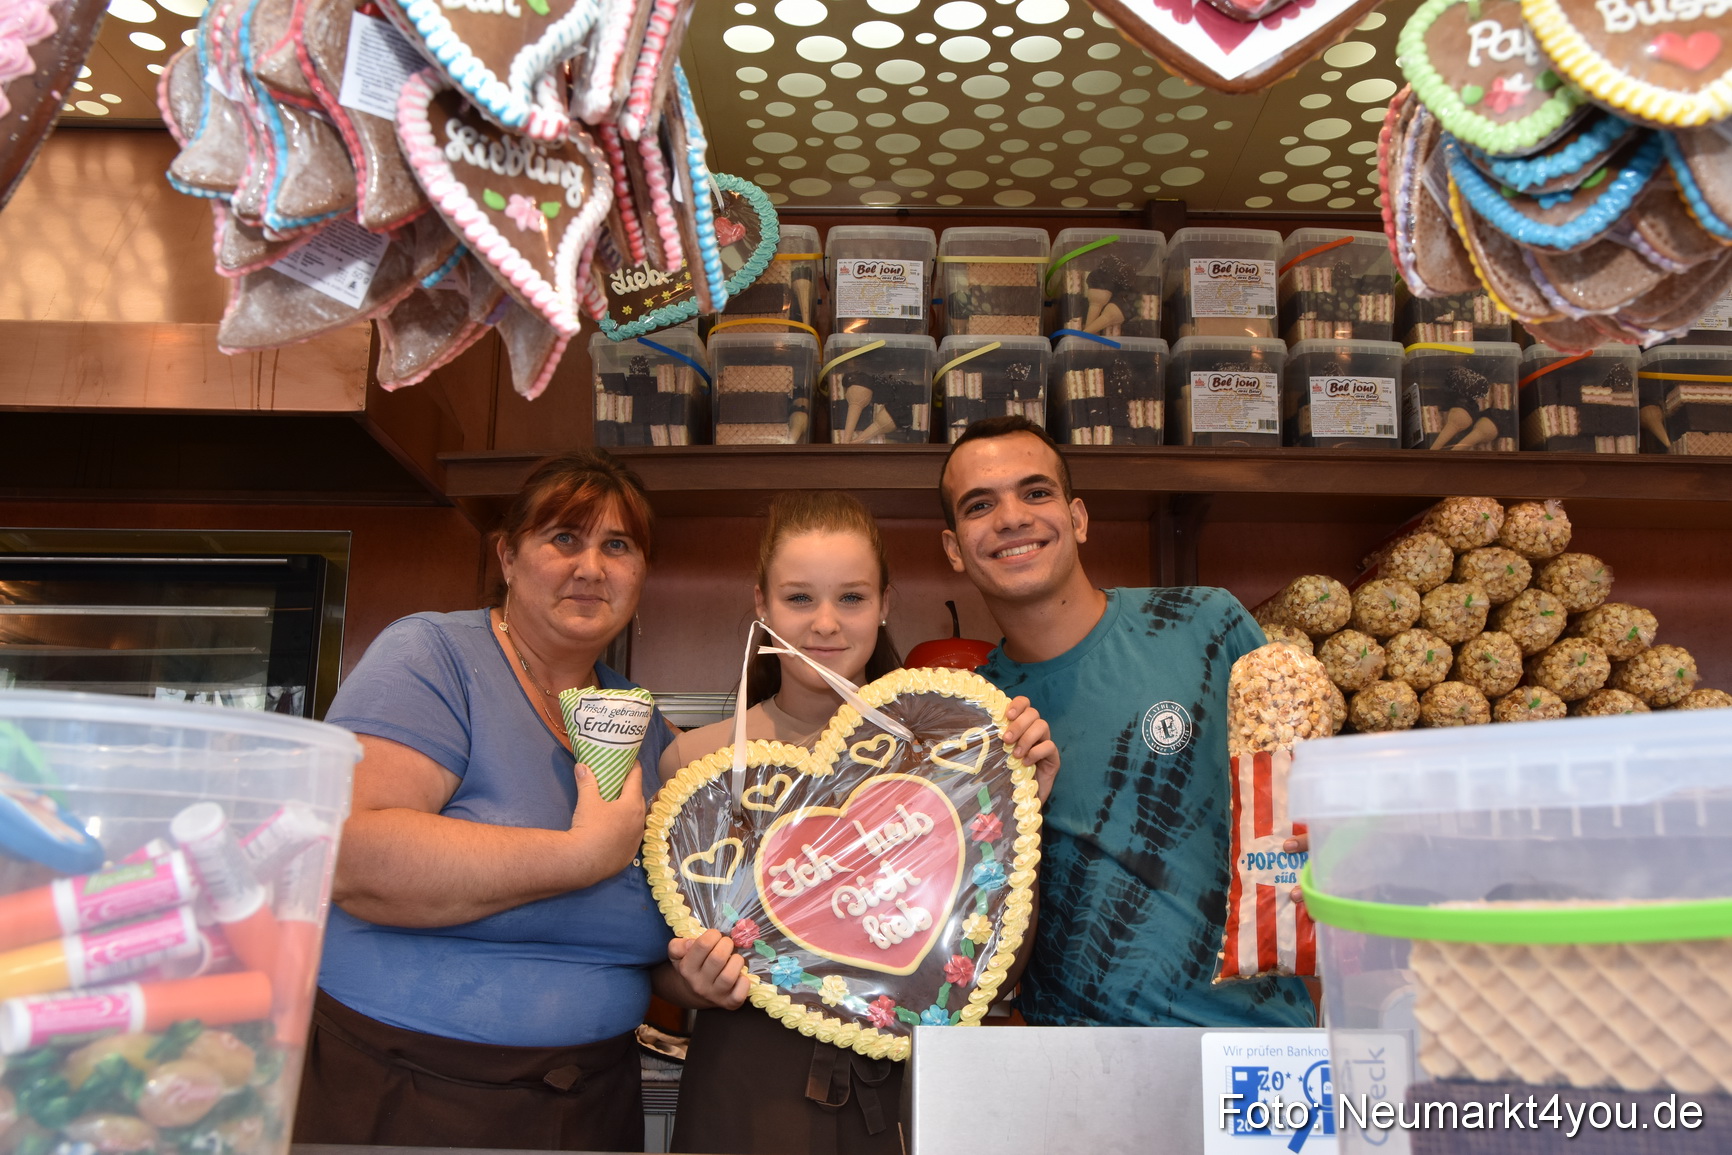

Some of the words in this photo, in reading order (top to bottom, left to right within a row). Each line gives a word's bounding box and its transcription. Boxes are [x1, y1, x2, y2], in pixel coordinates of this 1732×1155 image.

[444, 118, 585, 208] Liebling
[857, 264, 877, 275] Bel
[880, 265, 902, 275] jour
[1212, 264, 1232, 274] Bel
[1235, 264, 1256, 275] jour
[1212, 377, 1232, 388] Bel
[1235, 377, 1257, 388] jour
[1330, 382, 1350, 393] Bel
[1352, 383, 1374, 393] jour
[583, 703, 608, 714] frisch
[768, 843, 855, 898] Ich
[852, 804, 935, 857] hab
[1246, 851, 1309, 871] POPCOR
[1274, 871, 1297, 884] süß
[831, 859, 922, 919] Dich
[1222, 1045, 1243, 1057] Wir
[1247, 1045, 1283, 1060] prüfen
[1287, 1045, 1330, 1057] Bankno
[1257, 1070, 1285, 1091] 20
